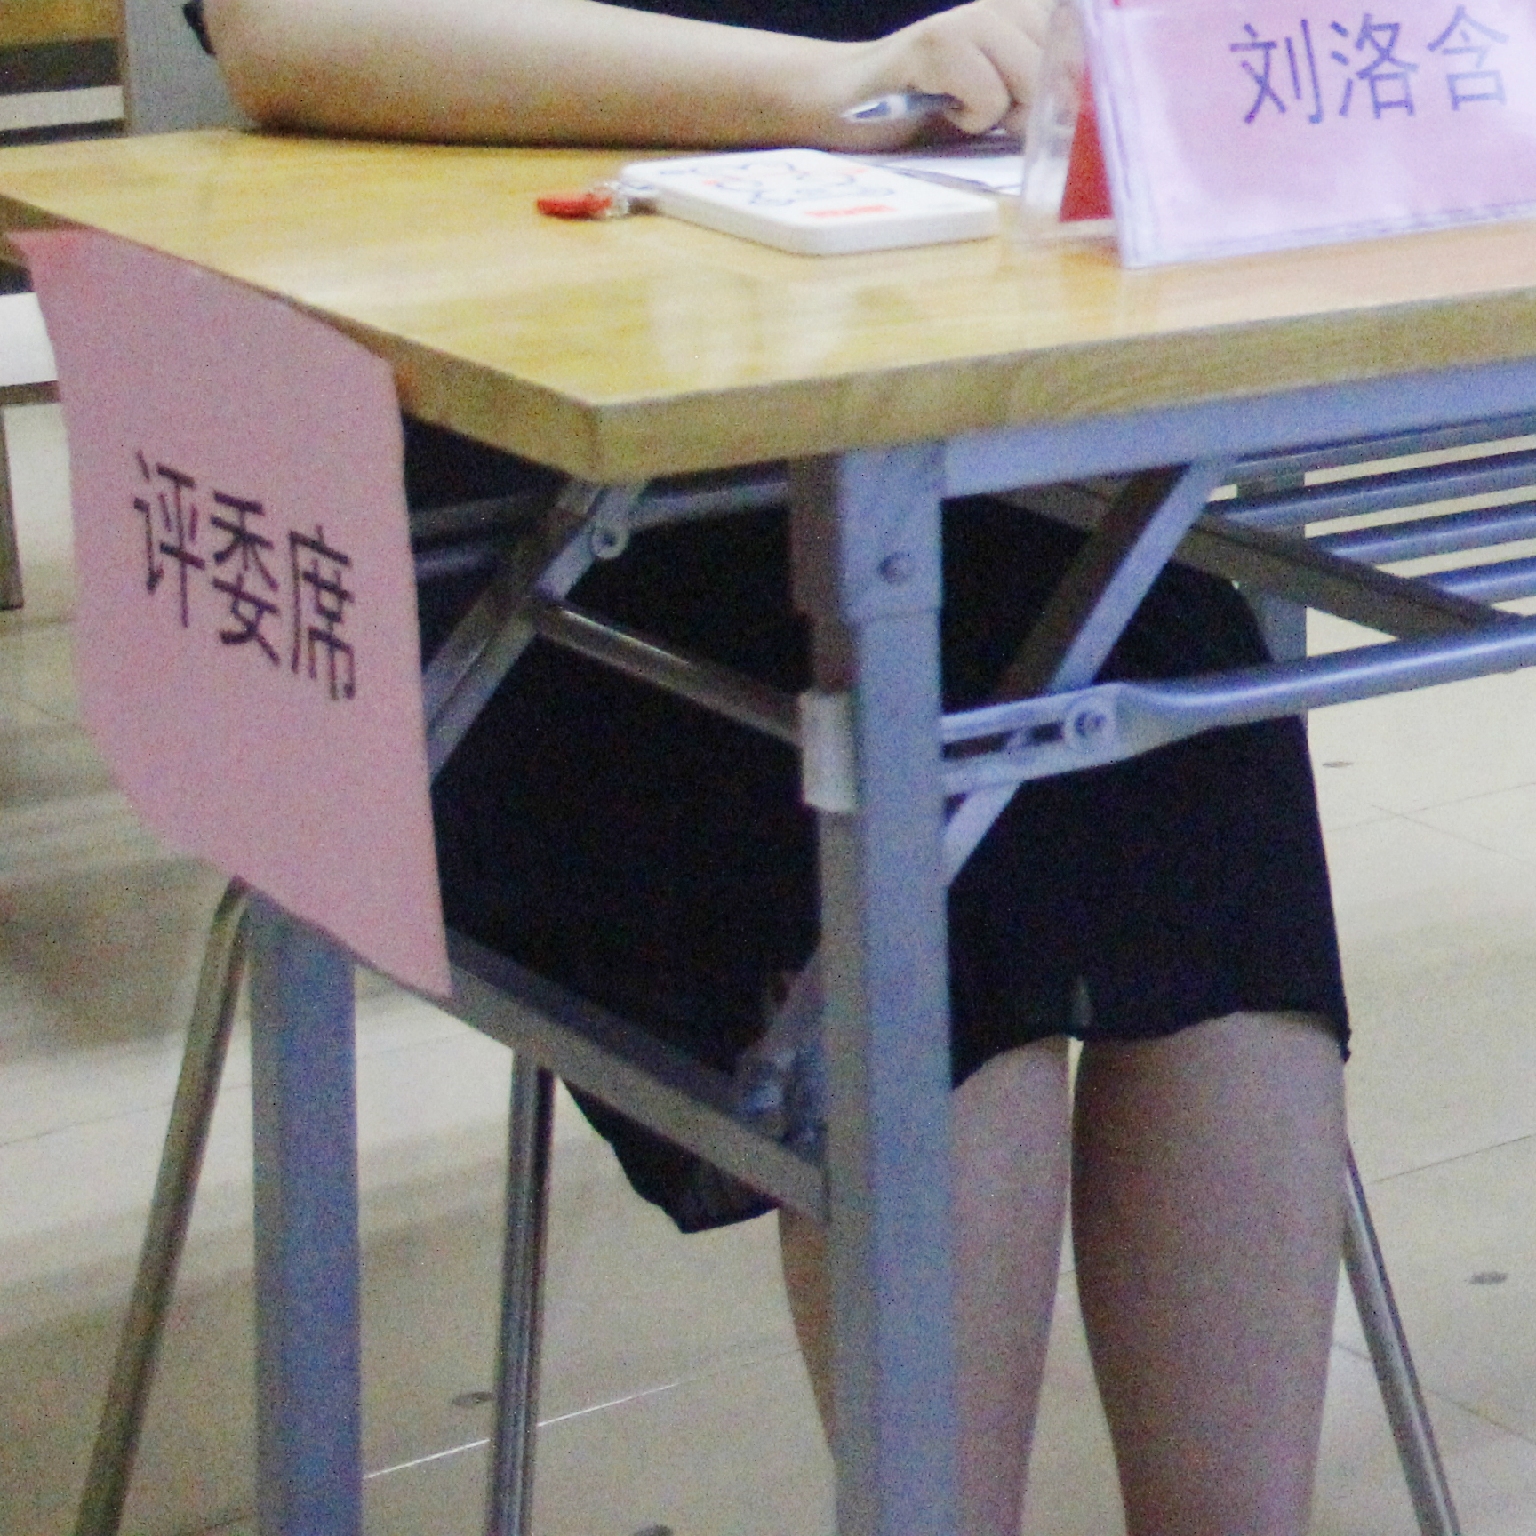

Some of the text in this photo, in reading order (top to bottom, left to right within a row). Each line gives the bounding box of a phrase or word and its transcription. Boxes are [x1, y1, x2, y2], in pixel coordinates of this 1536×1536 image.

[1229, 4, 1508, 124] 刘洛含
[133, 449, 357, 700] 评委席
